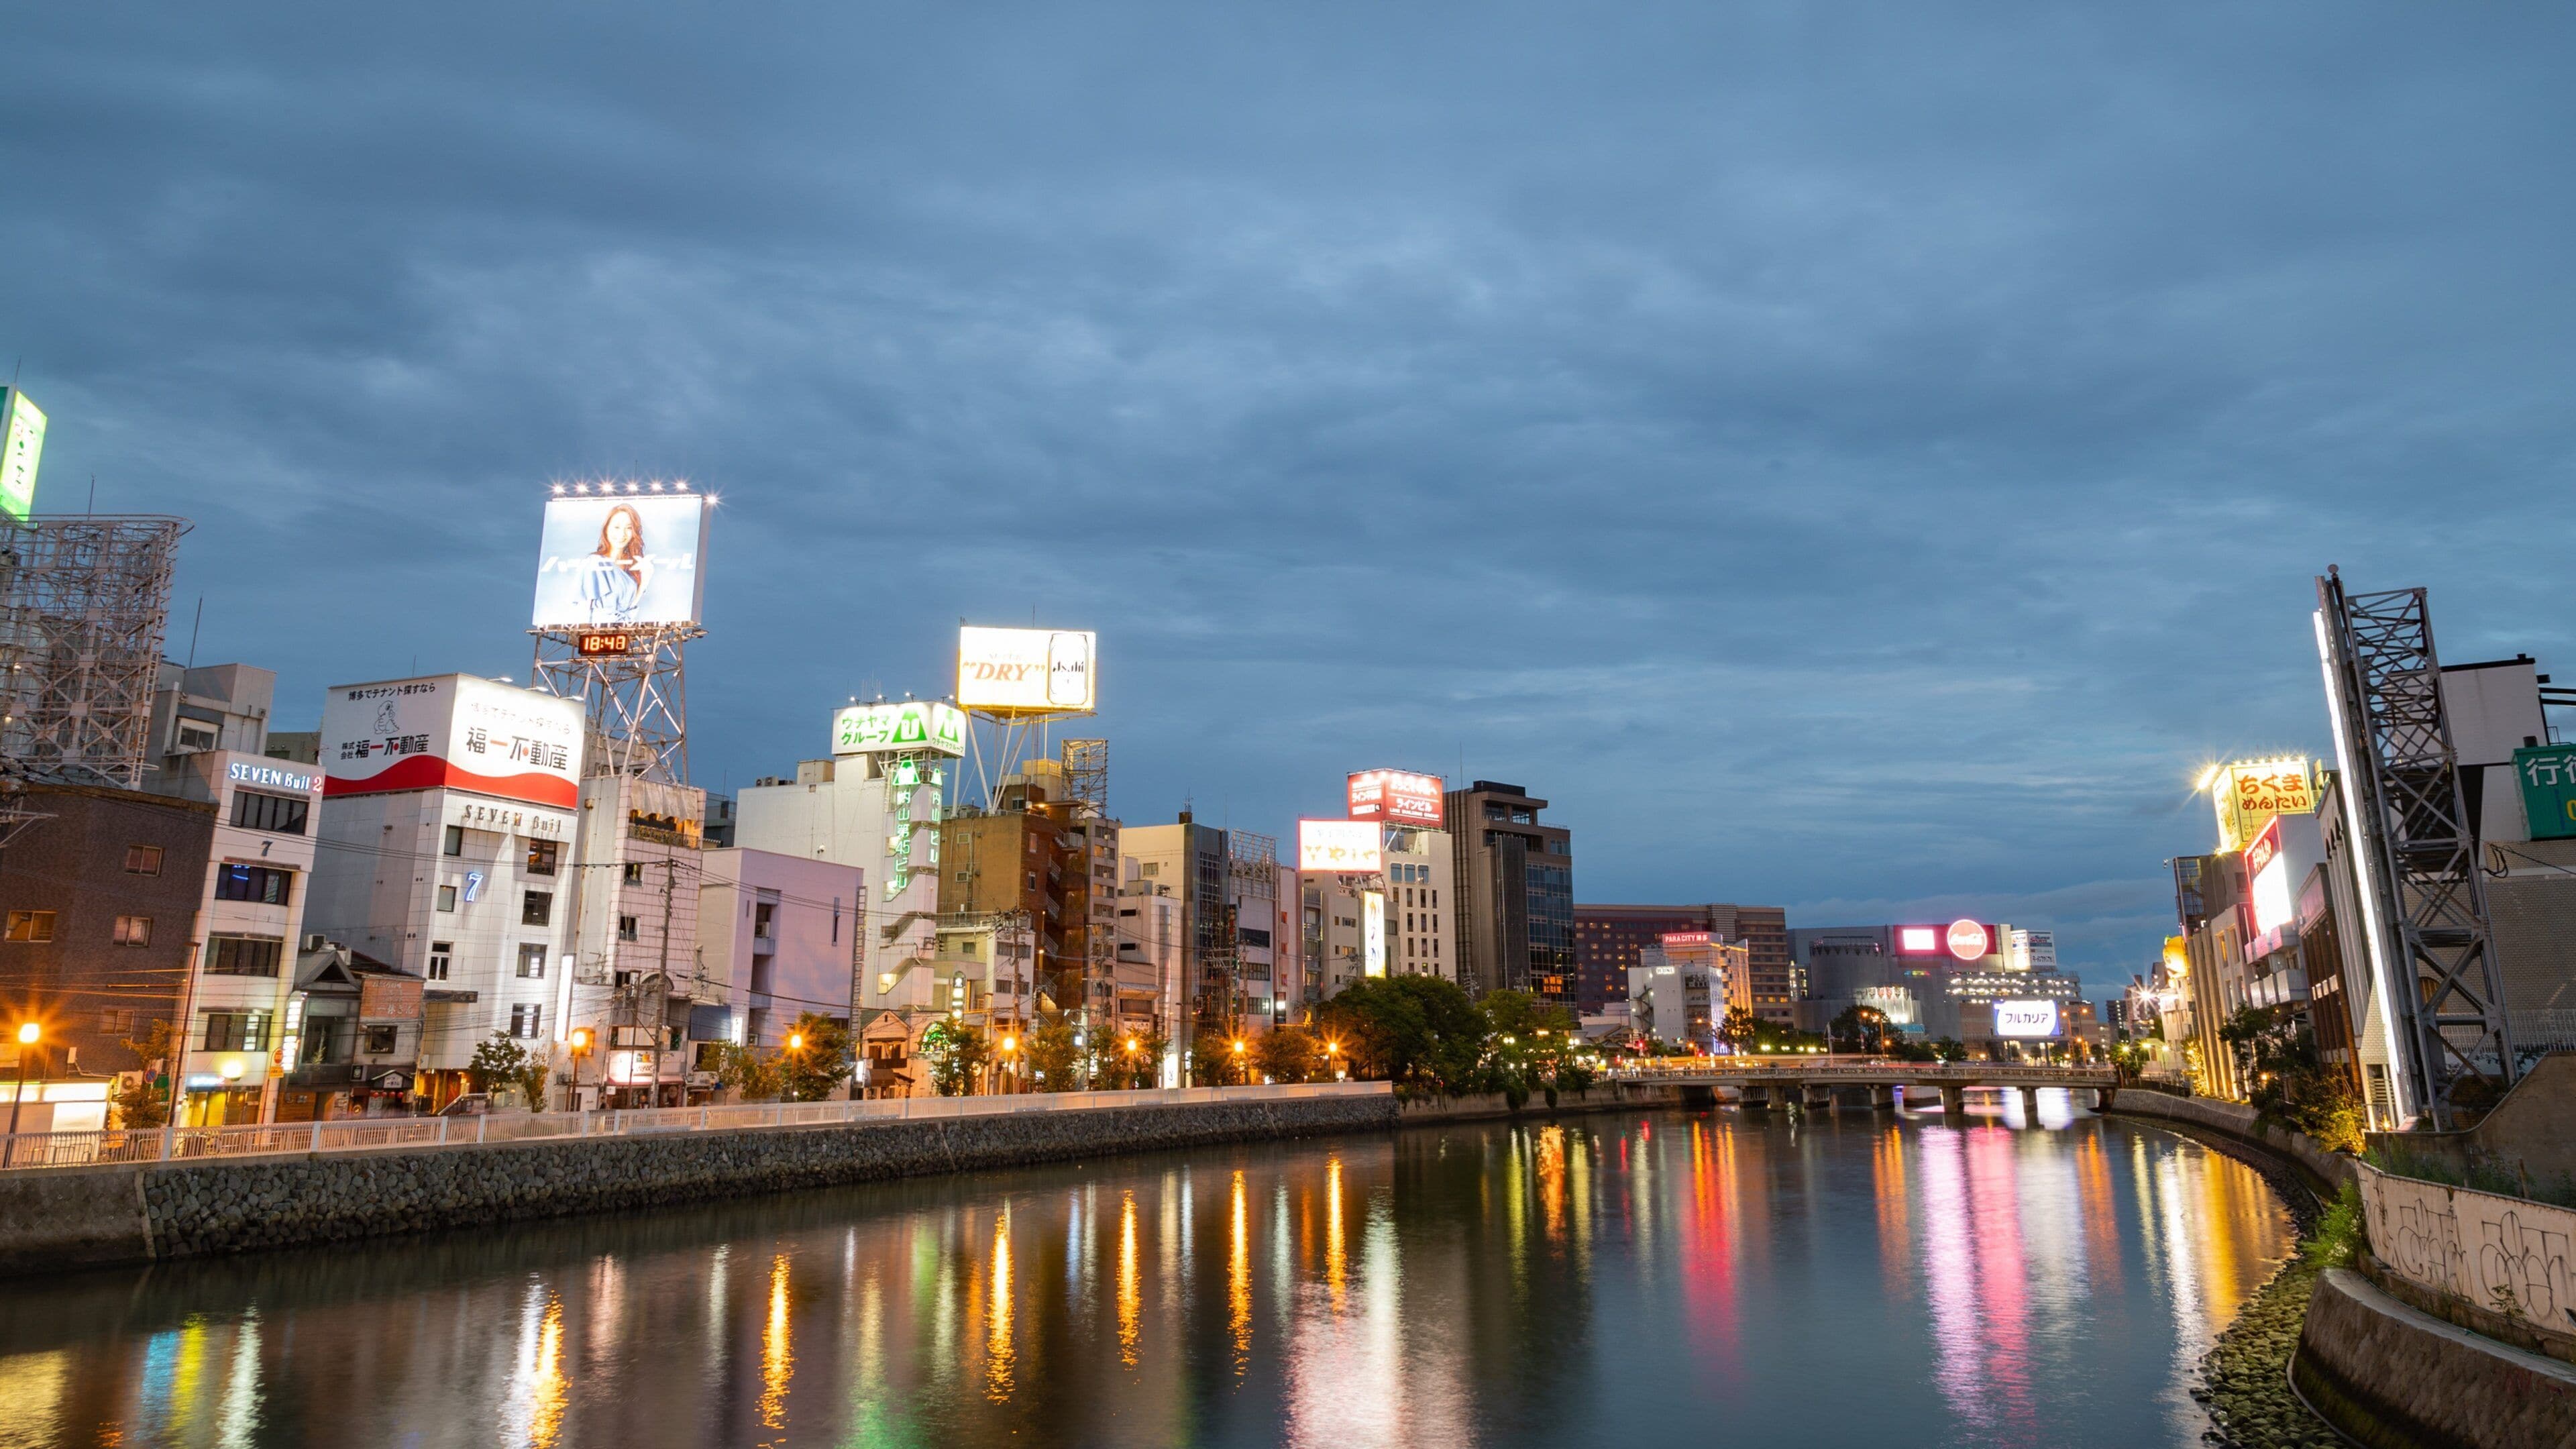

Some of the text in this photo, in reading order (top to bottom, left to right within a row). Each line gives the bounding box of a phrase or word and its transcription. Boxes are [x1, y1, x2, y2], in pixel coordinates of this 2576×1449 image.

[348, 682, 436, 701] 博多でテナント探すなら
[841, 714, 891, 730] ウチヤマ
[356, 734, 430, 758] 福一不動産
[466, 726, 568, 770] 福一不動産
[229, 762, 281, 785] SEVEN
[313, 776, 322, 792] 2
[2237, 773, 2304, 794] ちくま
[2242, 795, 2307, 810] めんたい
[464, 804, 522, 827] SEVEN
[262, 841, 272, 856] 7
